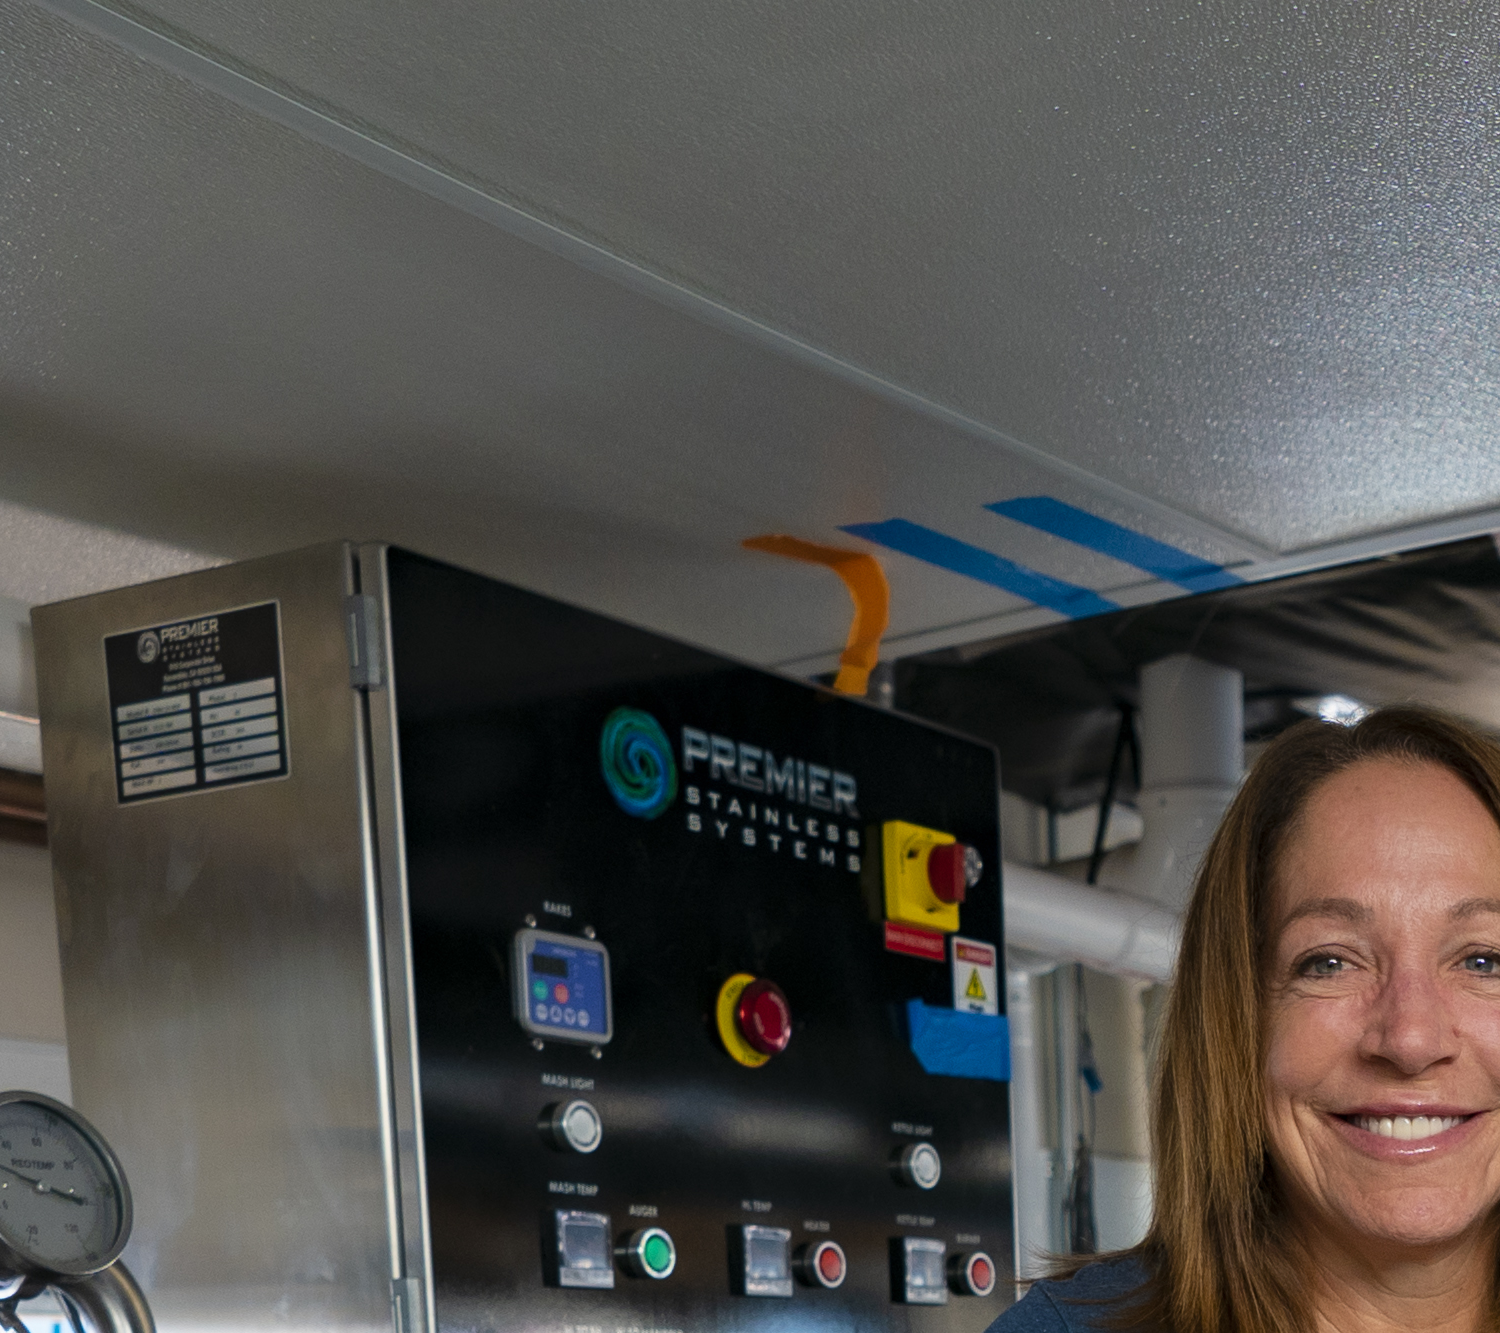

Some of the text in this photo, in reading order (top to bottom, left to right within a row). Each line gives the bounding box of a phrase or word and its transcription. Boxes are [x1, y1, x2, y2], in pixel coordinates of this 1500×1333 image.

[160, 617, 219, 644] PREMIER
[681, 725, 861, 820] PREMIER
[686, 785, 860, 848] STAINLESS
[687, 812, 861, 874] SYSTEMS
[543, 900, 573, 918] RAKES
[541, 1072, 595, 1092] MASH LIGHT
[10, 1157, 56, 1171] REOTEMP
[548, 1180, 599, 1198] MASH TEMP
[628, 1203, 659, 1219] AUGER
